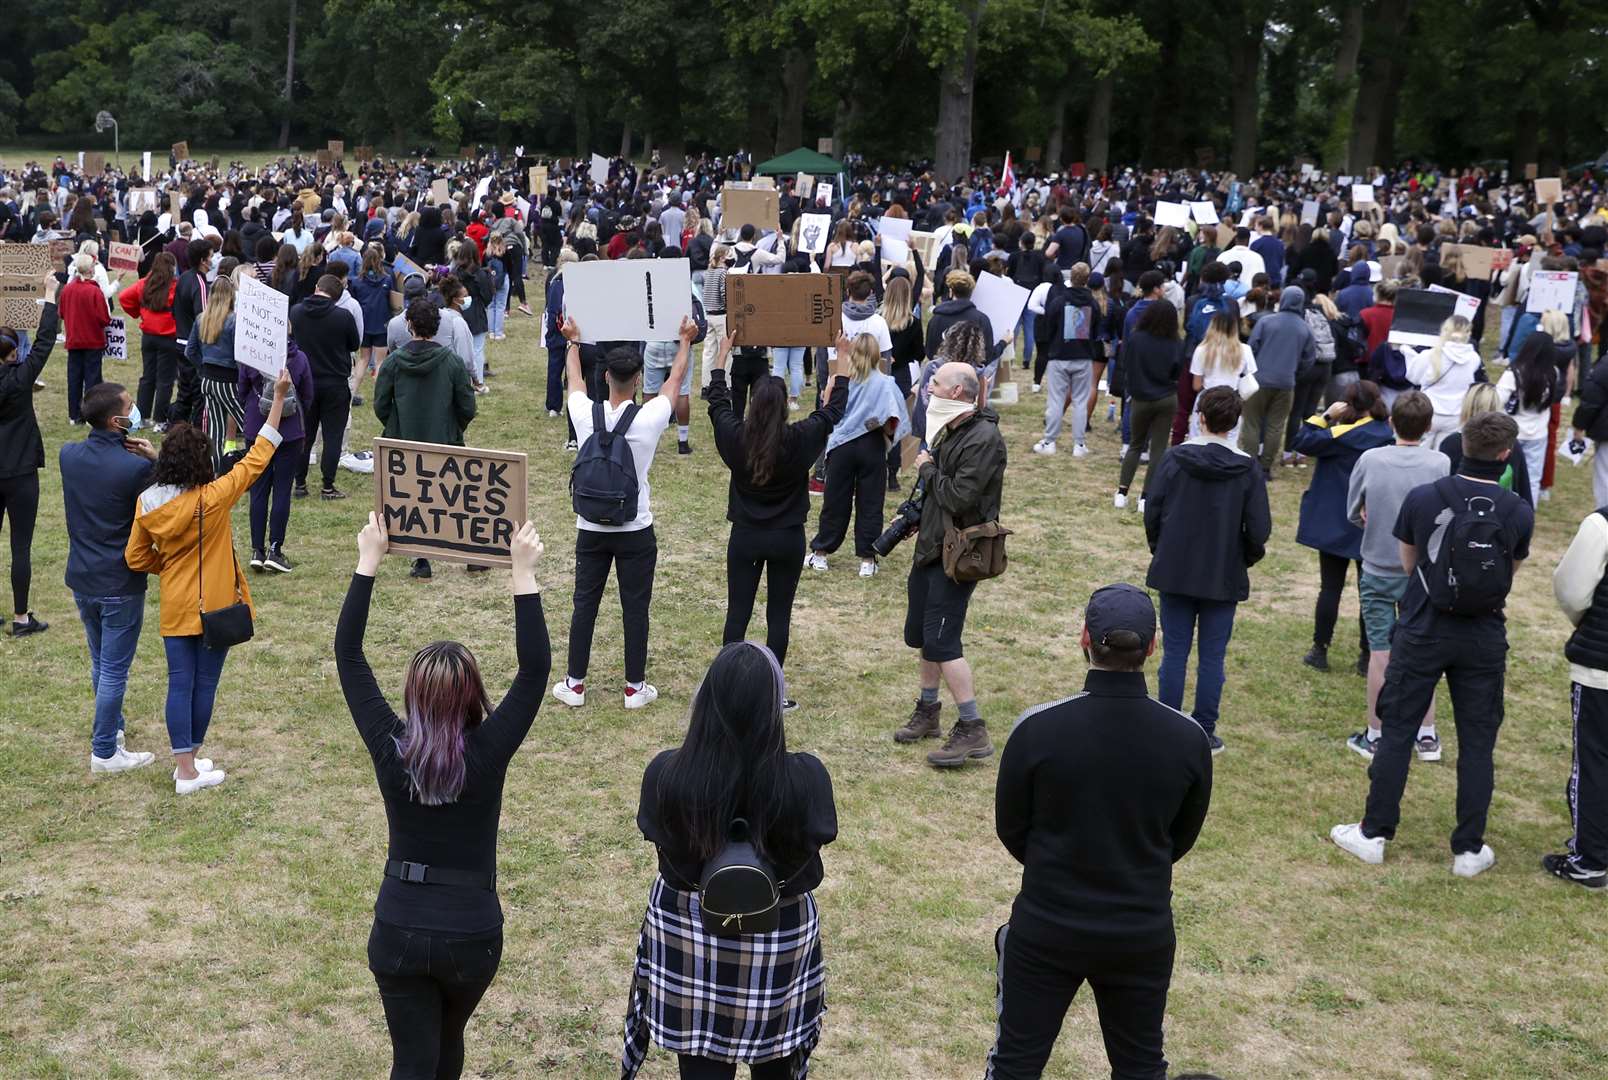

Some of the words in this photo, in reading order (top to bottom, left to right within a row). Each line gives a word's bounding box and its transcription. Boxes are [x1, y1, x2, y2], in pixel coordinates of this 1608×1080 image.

[115, 246, 139, 258] CAN'T
[243, 283, 281, 306] JUSTICE
[242, 316, 260, 331] MUCH
[264, 326, 272, 336] TO
[251, 303, 272, 320] NOT
[274, 316, 285, 327] TOO
[245, 329, 258, 341] ASK
[388, 449, 511, 489] BLACK
[389, 475, 509, 516] LIVES
[384, 503, 514, 547] MATTER
